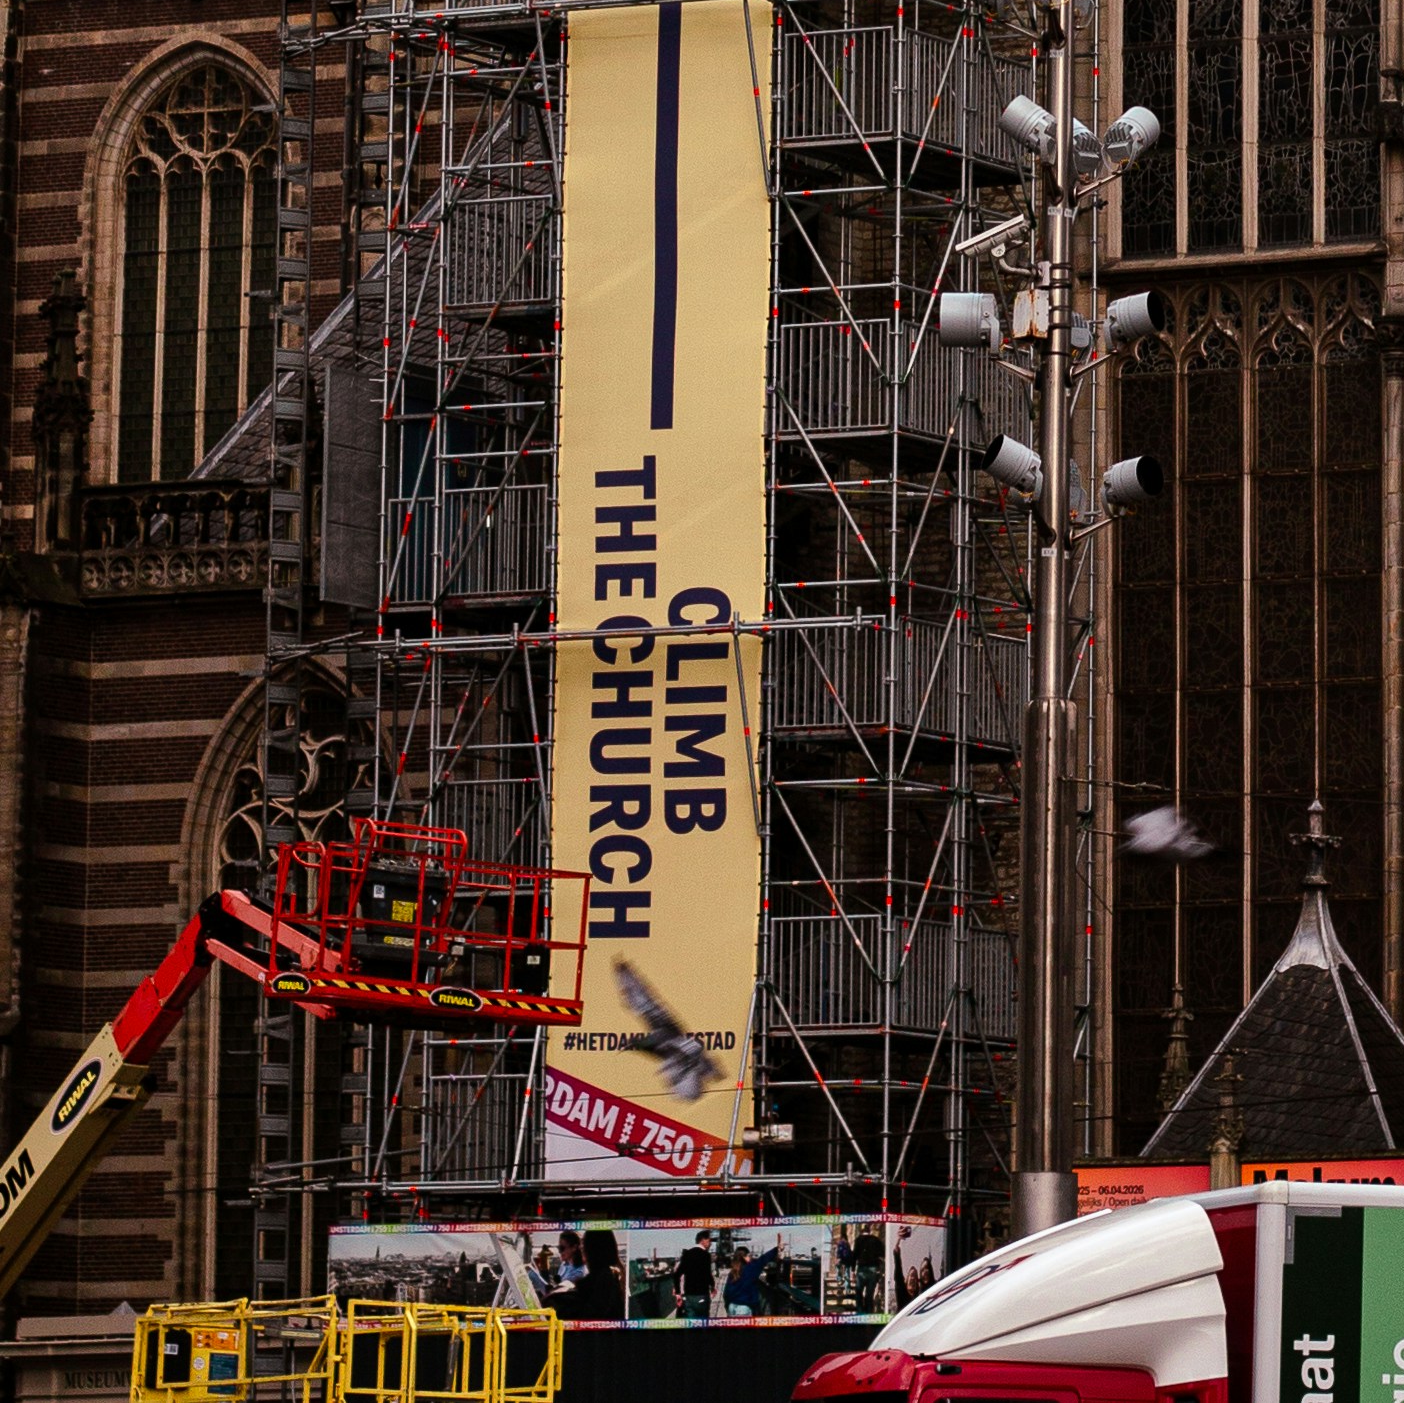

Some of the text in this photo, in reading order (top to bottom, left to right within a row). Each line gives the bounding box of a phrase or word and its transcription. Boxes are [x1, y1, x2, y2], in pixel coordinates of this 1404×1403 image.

[588, 455, 658, 939] THE CHURCH
[663, 586, 733, 835] CLIMB
[277, 980, 305, 991] RIWAL
[438, 994, 475, 1007] RIWAL
[58, 1071, 97, 1122] RIWAL
[638, 1118, 694, 1170] 750
[1098, 1185, 1144, 1195] 06.04.2026
[1108, 1197, 1130, 1207] Open
[392, 1225, 433, 1233] AMSTERDAM
[438, 1225, 450, 1233] 750
[455, 1224, 496, 1232] AMSTERDAM
[518, 1222, 559, 1231] AMSTERDAM
[564, 1222, 577, 1230] 750
[627, 1220, 640, 1228] 750
[645, 1219, 686, 1228] AMSTERDAM
[756, 1217, 768, 1225] 750
[774, 1216, 816, 1225] AMSTERDAM
[839, 1214, 882, 1223] AMSTERDAM
[579, 1320, 621, 1329] AMSTERDAM
[626, 1320, 638, 1328] 750
[708, 1318, 751, 1327] AMSTERDAM
[820, 1316, 833, 1324] 750
[838, 1315, 881, 1324] AMSTERDAM
